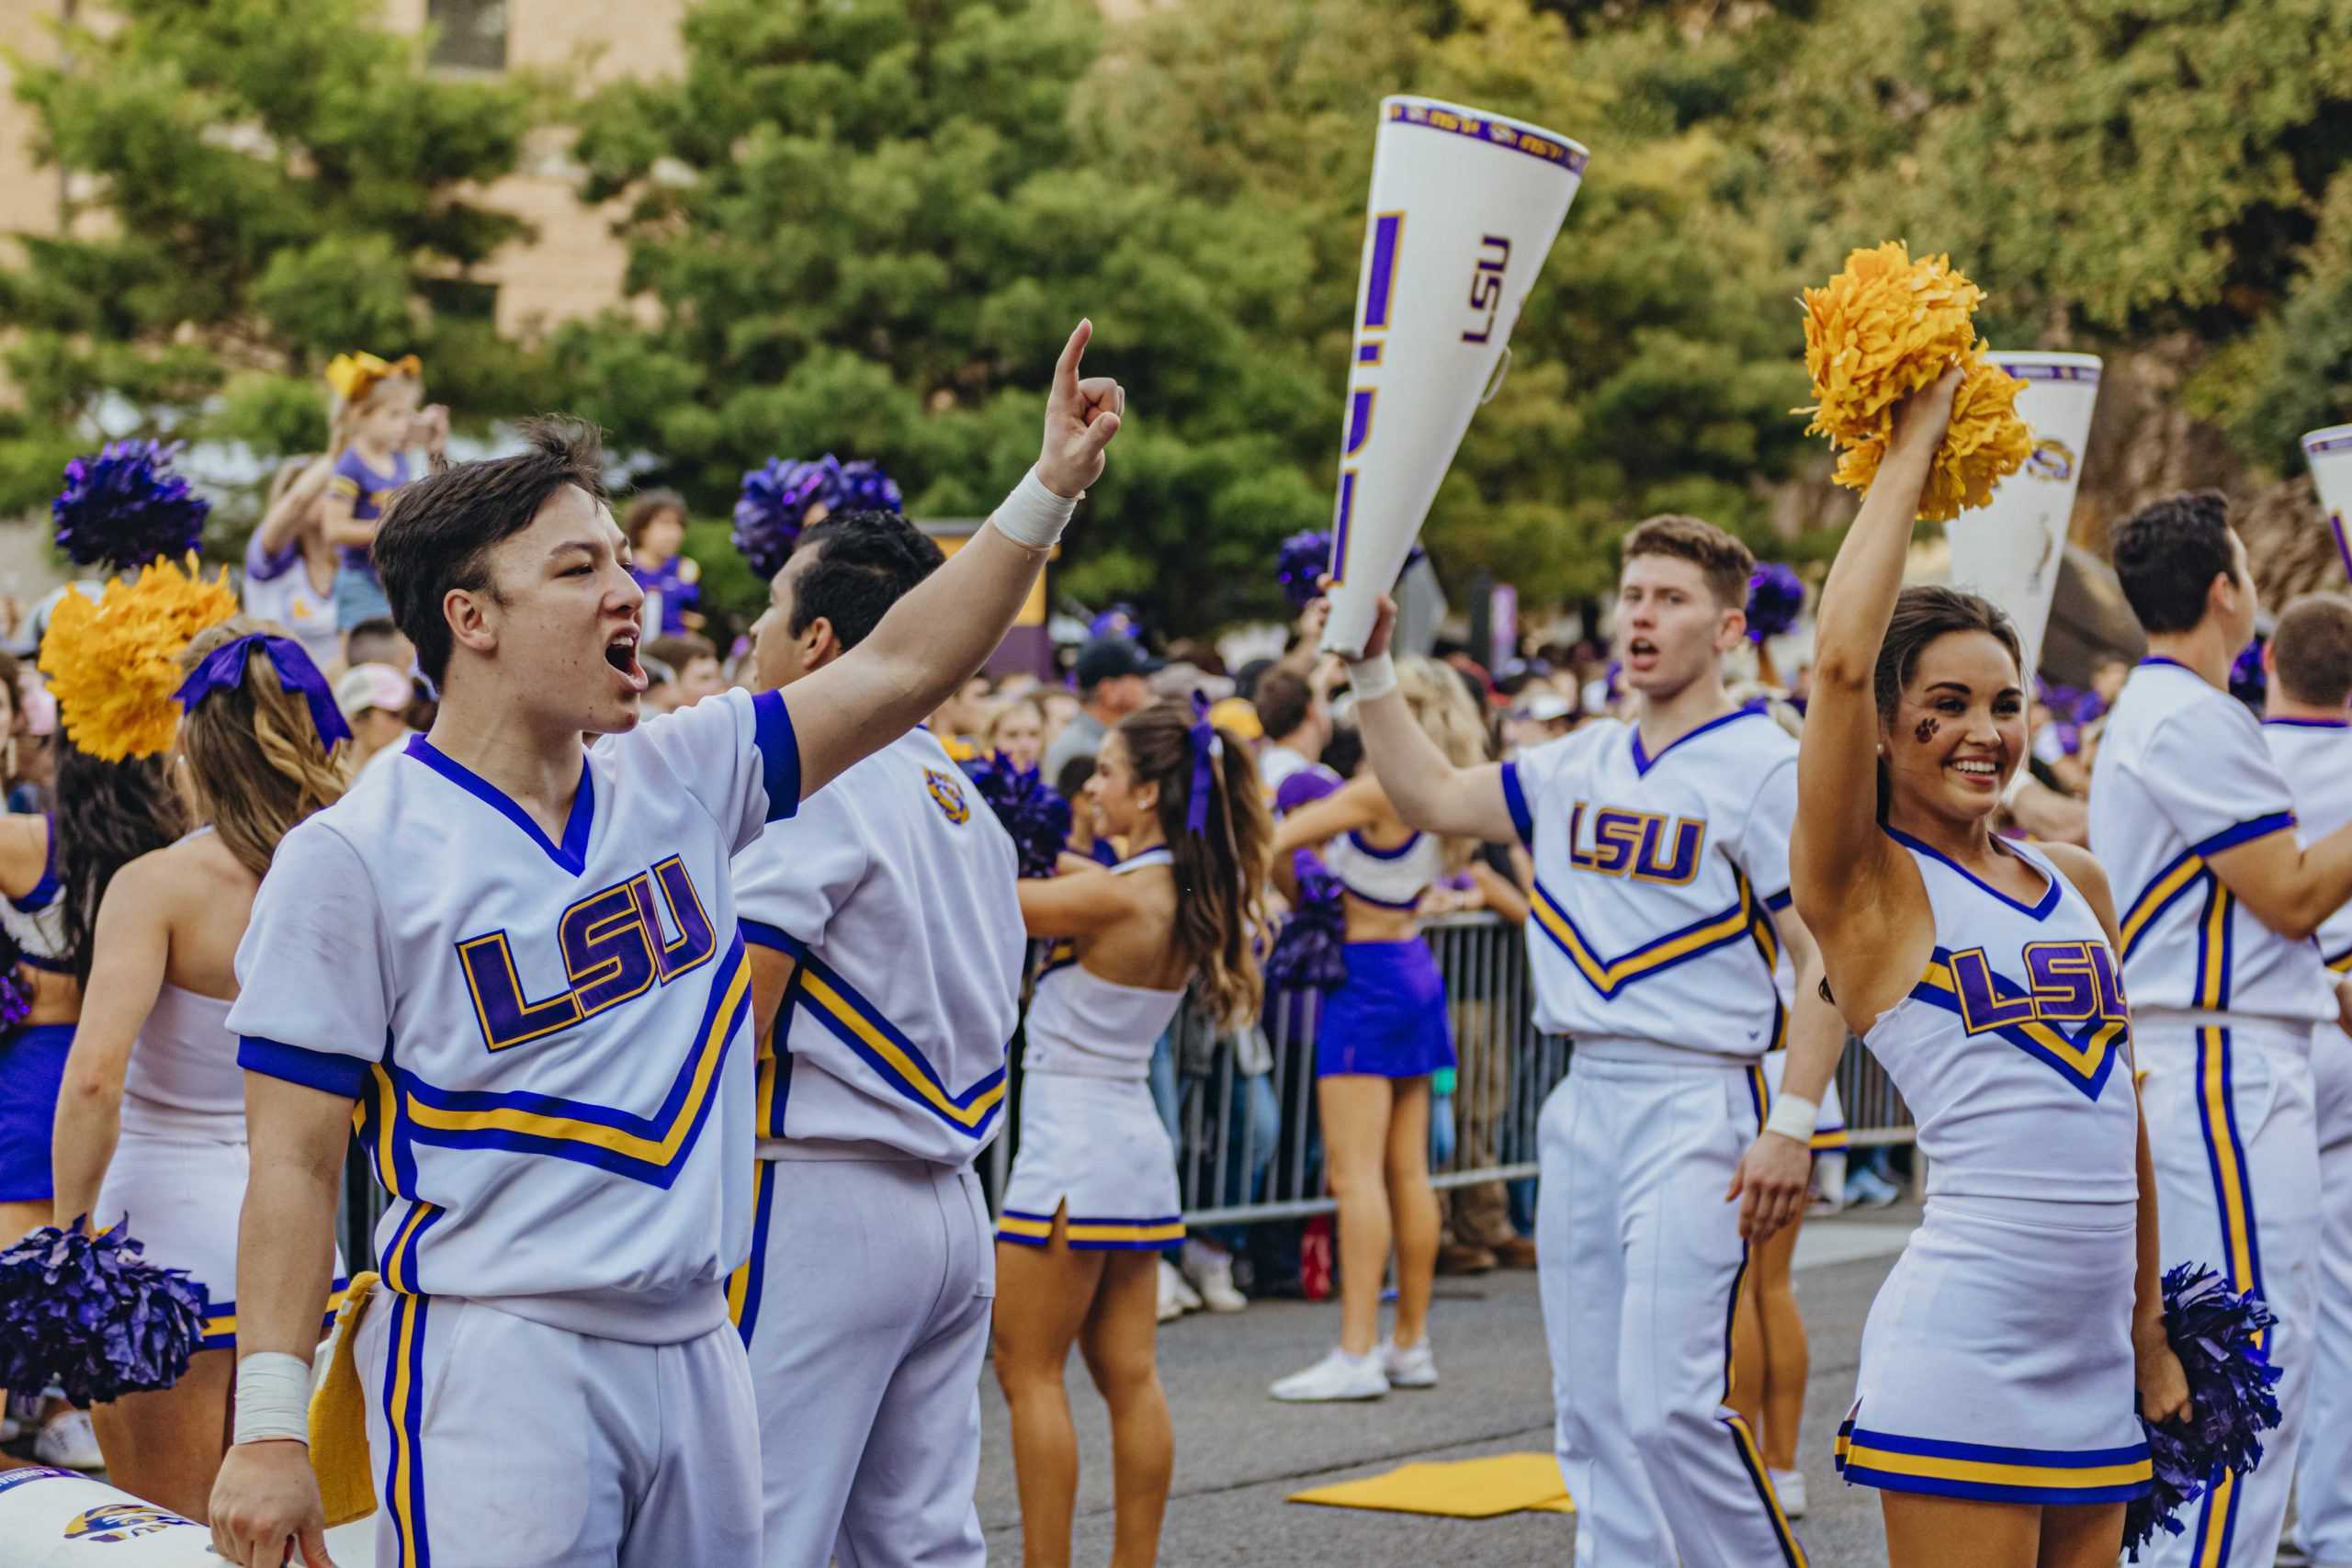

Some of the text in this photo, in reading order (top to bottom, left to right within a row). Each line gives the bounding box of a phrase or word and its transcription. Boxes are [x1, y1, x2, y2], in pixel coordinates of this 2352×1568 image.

[1461, 235, 1510, 344] LSU
[1570, 801, 1707, 886] LSU
[456, 853, 717, 1053] LSU
